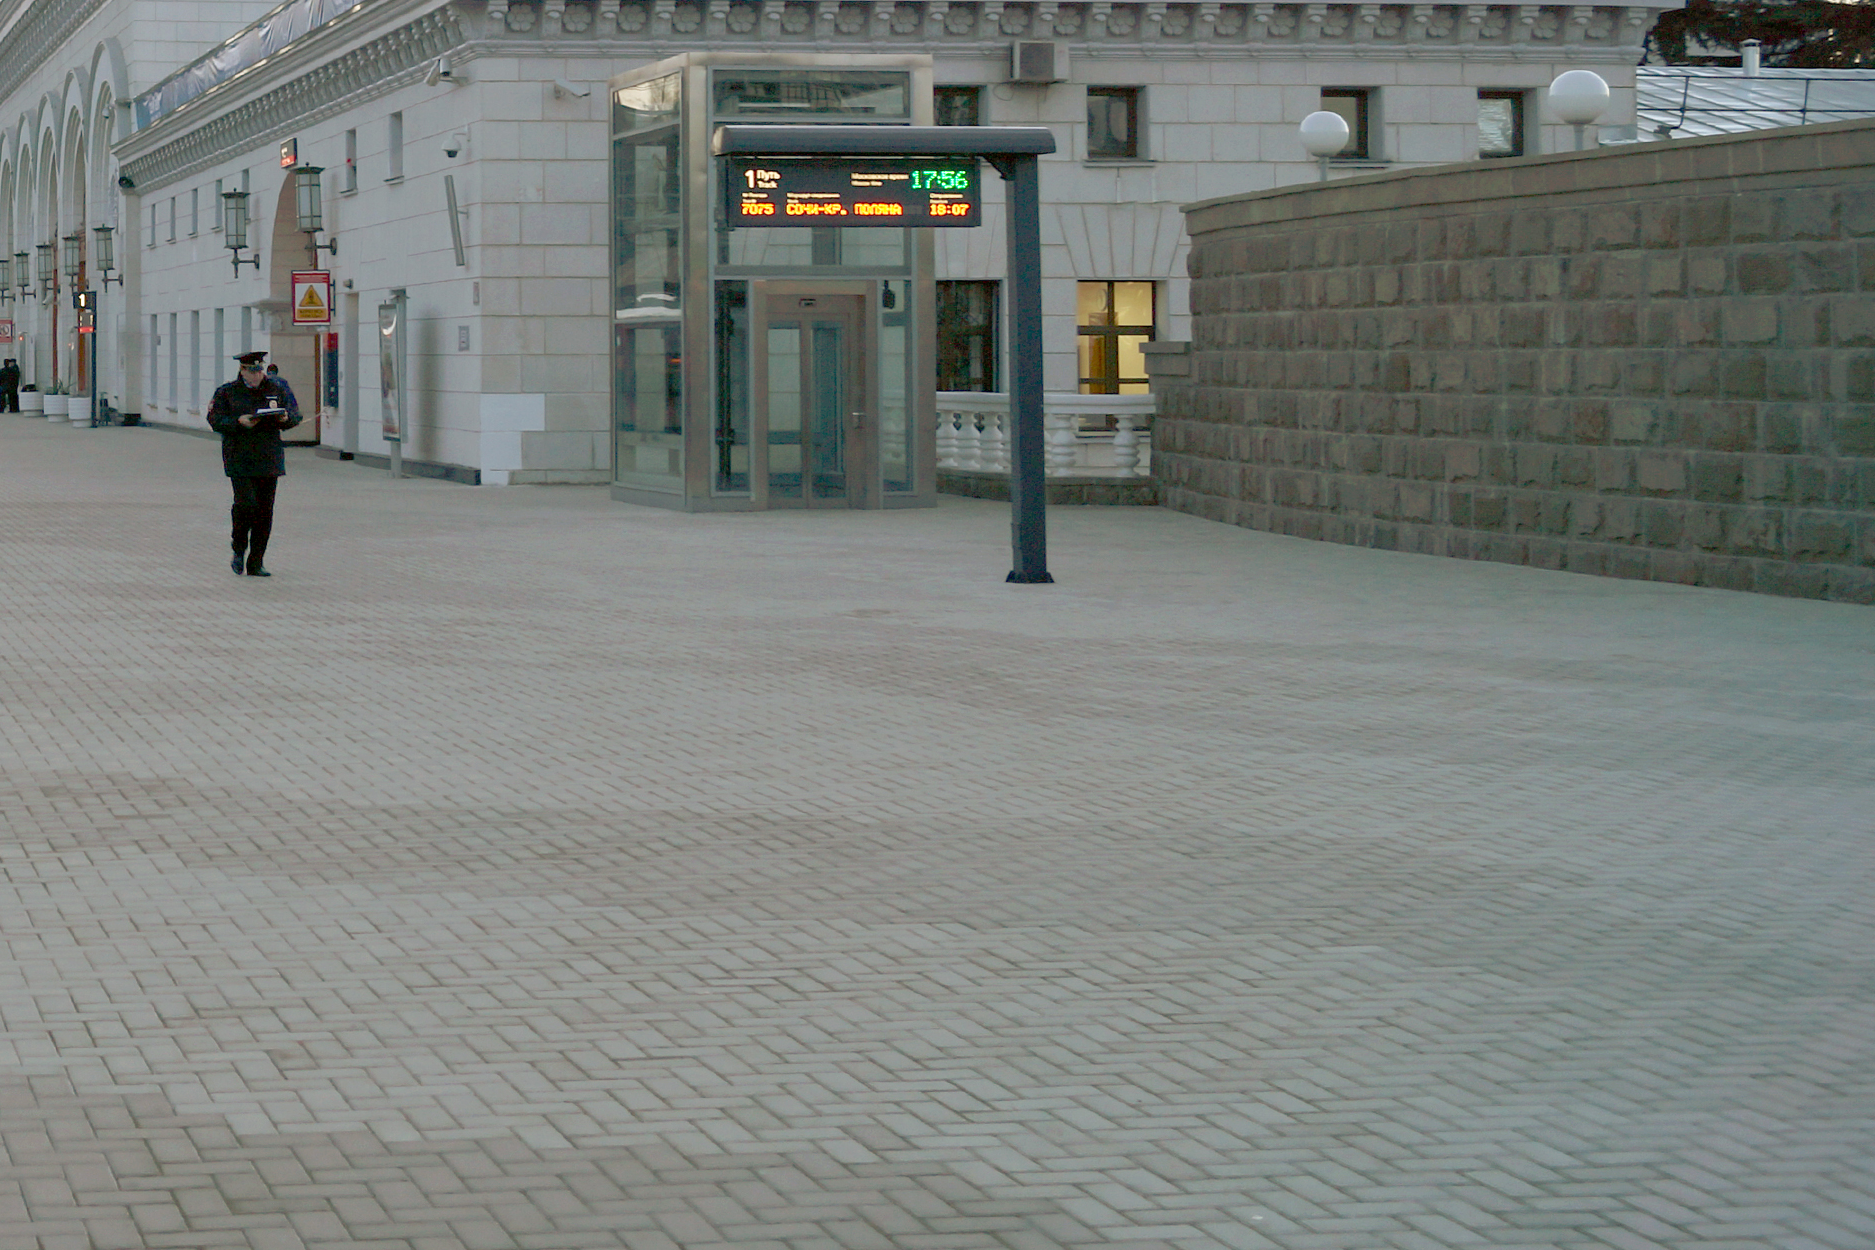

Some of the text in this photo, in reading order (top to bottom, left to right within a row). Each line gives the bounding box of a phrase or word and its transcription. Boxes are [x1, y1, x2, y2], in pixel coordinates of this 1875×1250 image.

[744, 169, 755, 189] 1
[756, 169, 781, 181] Путь
[911, 170, 968, 189] 17:56
[741, 203, 775, 216] 7075
[853, 203, 903, 216] ПОЛЯНА
[929, 203, 970, 216] 18:07
[78, 293, 86, 307] 1
